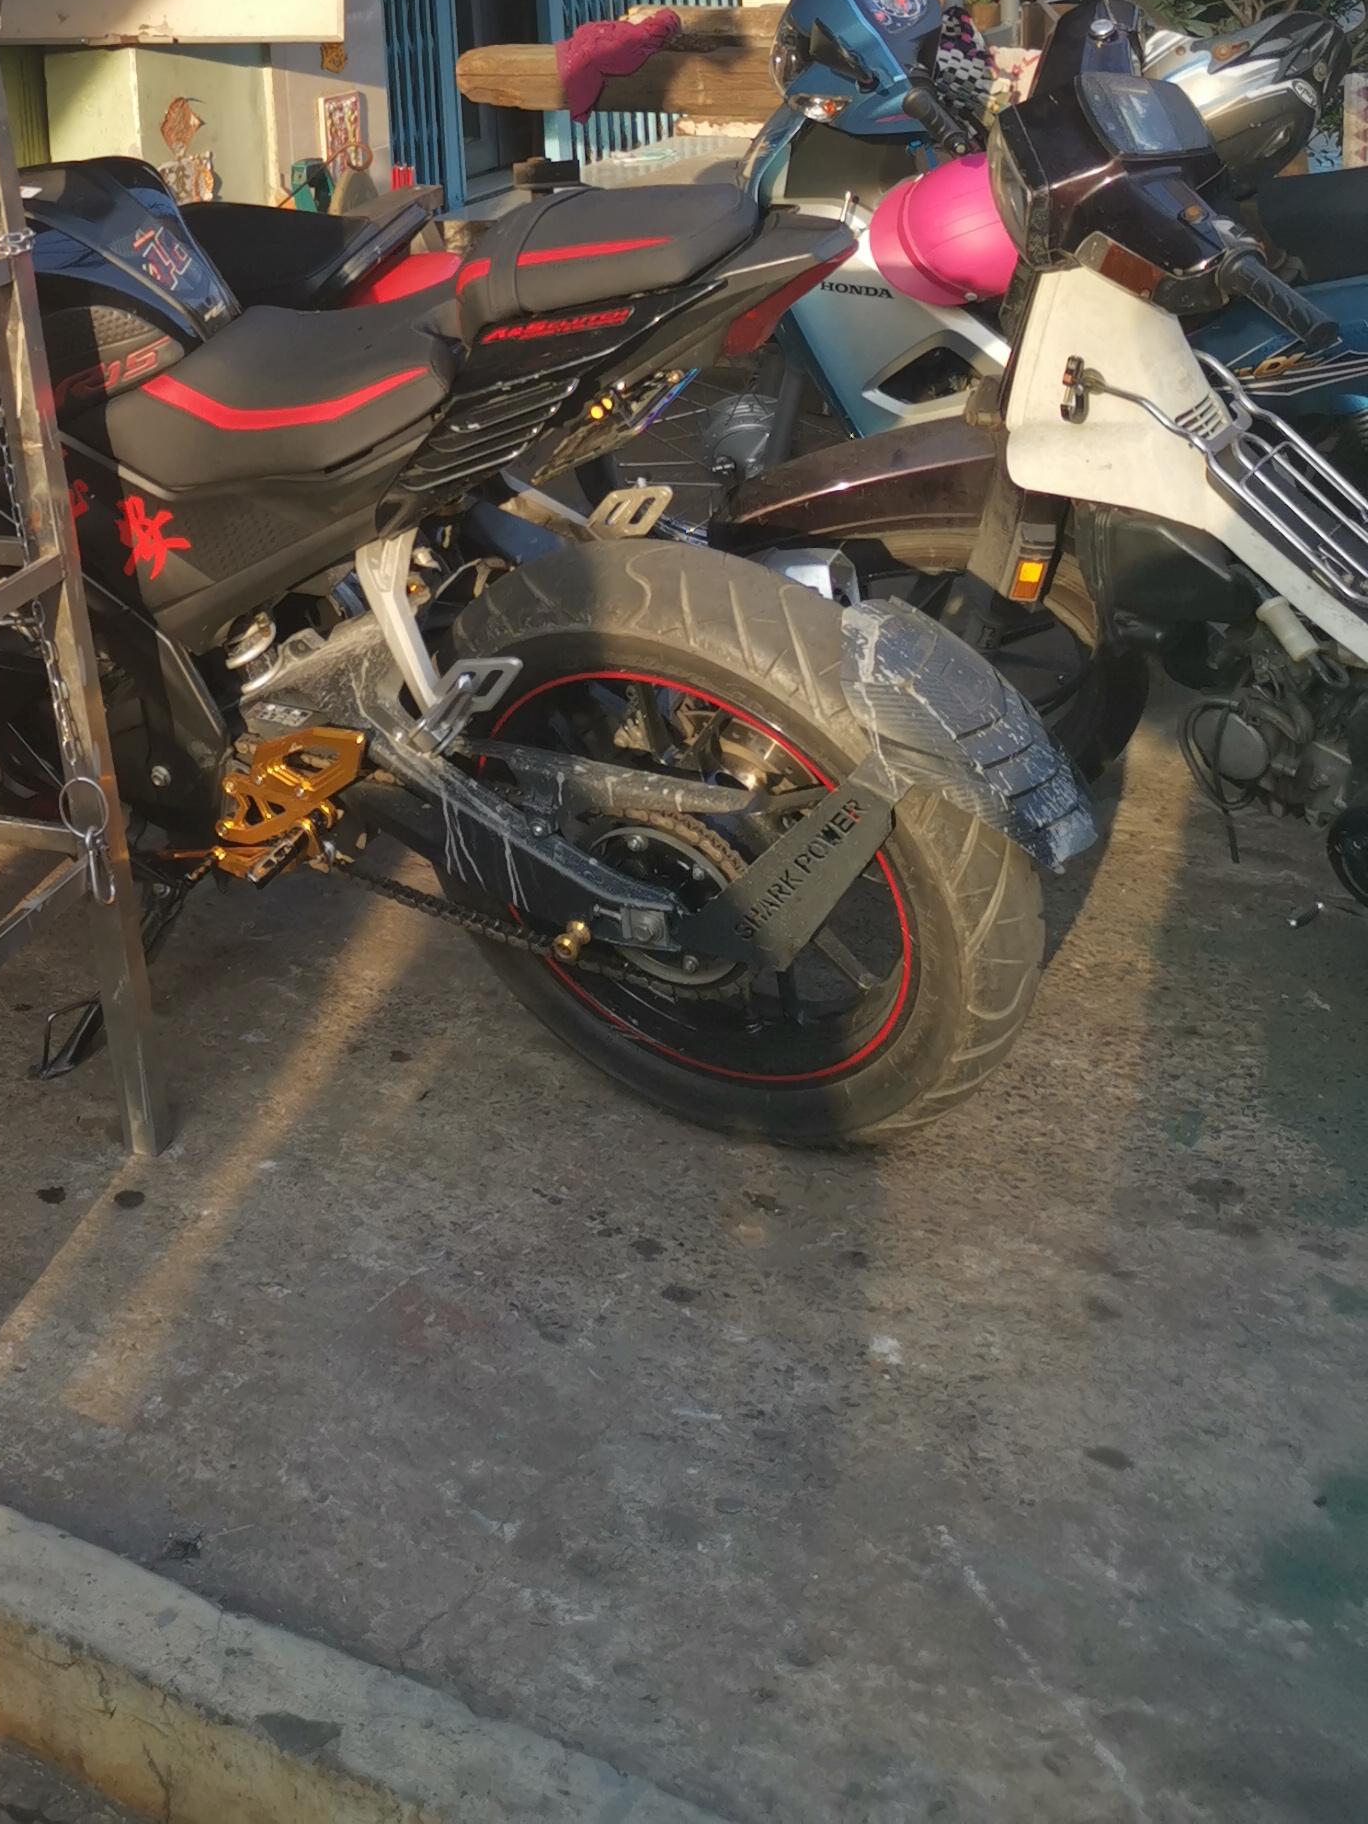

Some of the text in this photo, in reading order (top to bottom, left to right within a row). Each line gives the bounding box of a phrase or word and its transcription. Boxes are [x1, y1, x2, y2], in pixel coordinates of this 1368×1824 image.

[820, 281, 895, 300] HONDA
[733, 798, 866, 941] SHARK POWER
